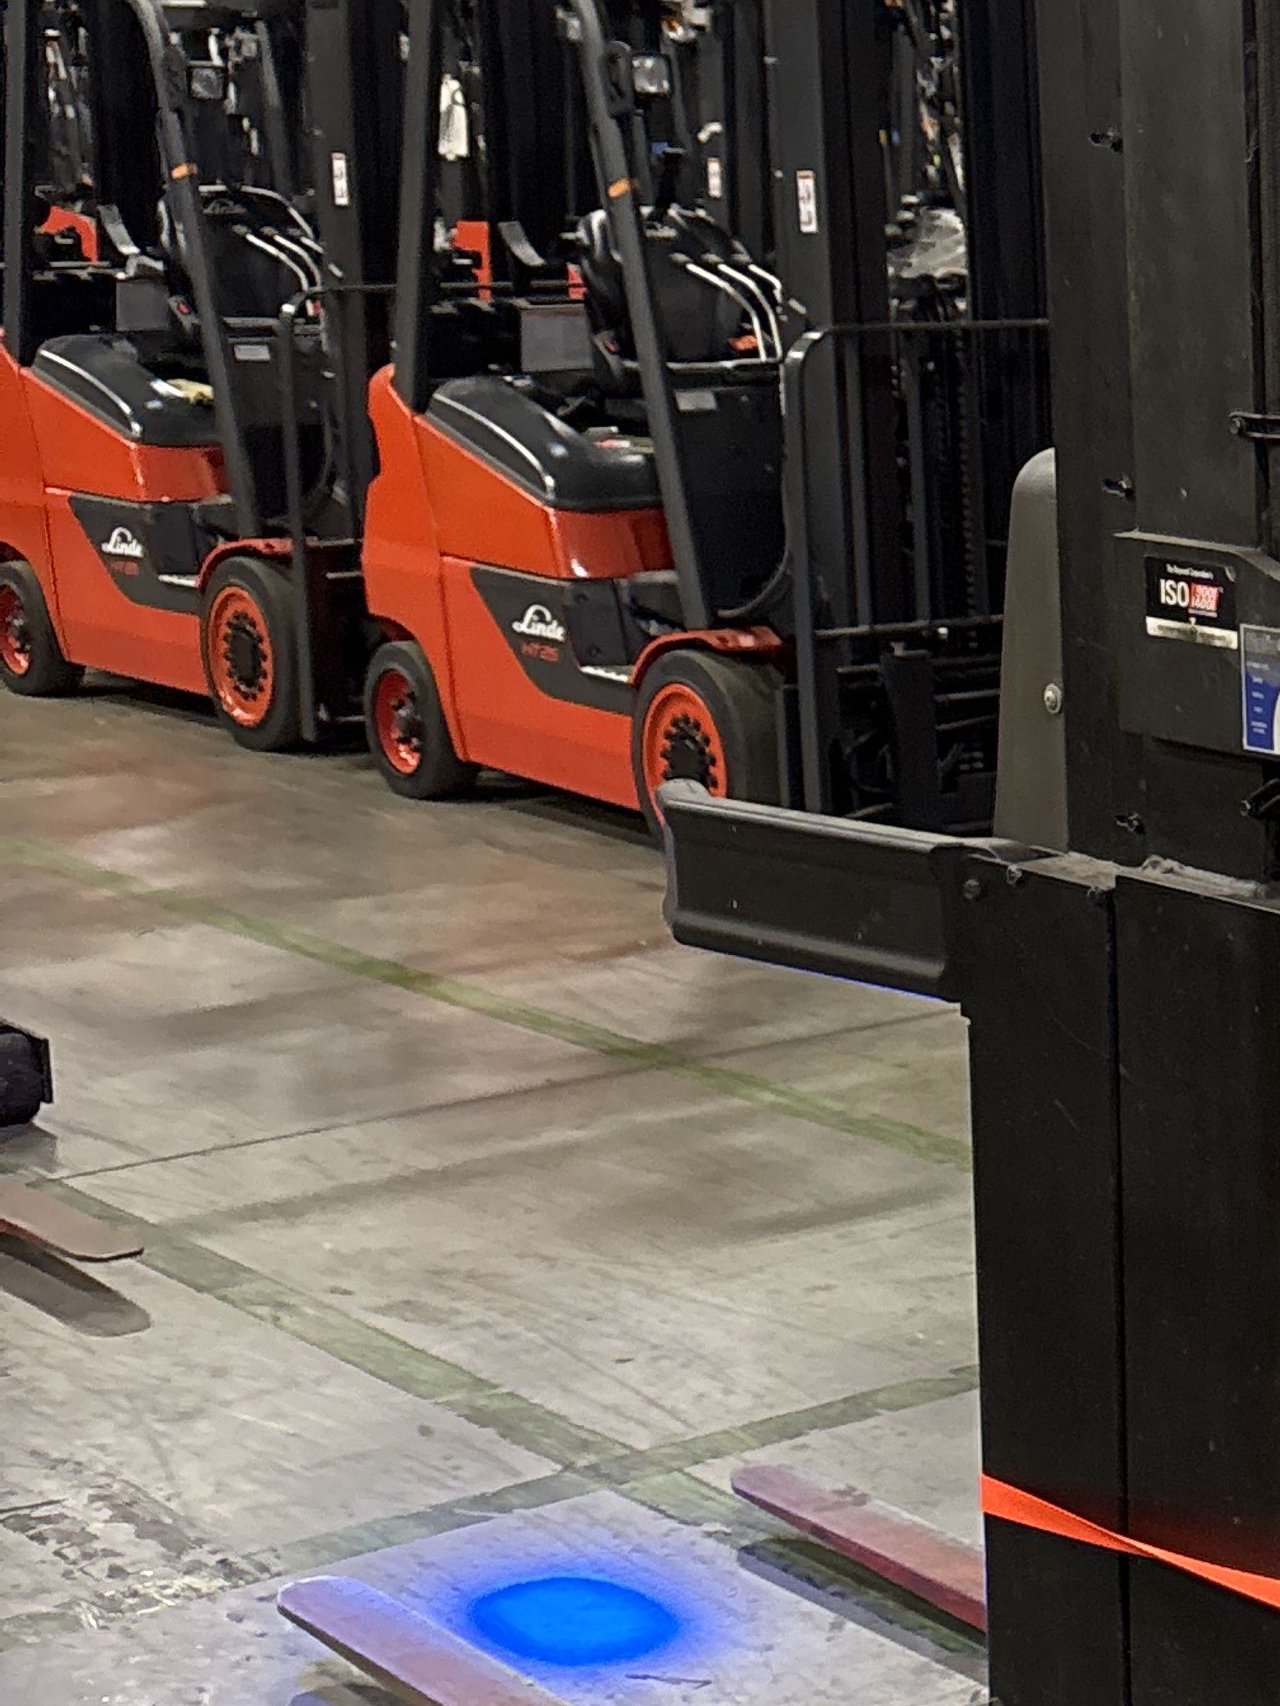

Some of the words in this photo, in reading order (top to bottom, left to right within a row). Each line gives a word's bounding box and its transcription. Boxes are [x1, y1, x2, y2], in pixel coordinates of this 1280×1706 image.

[101, 526, 144, 558] Linde
[1160, 578, 1189, 607] ISO
[512, 604, 566, 642] Linde
